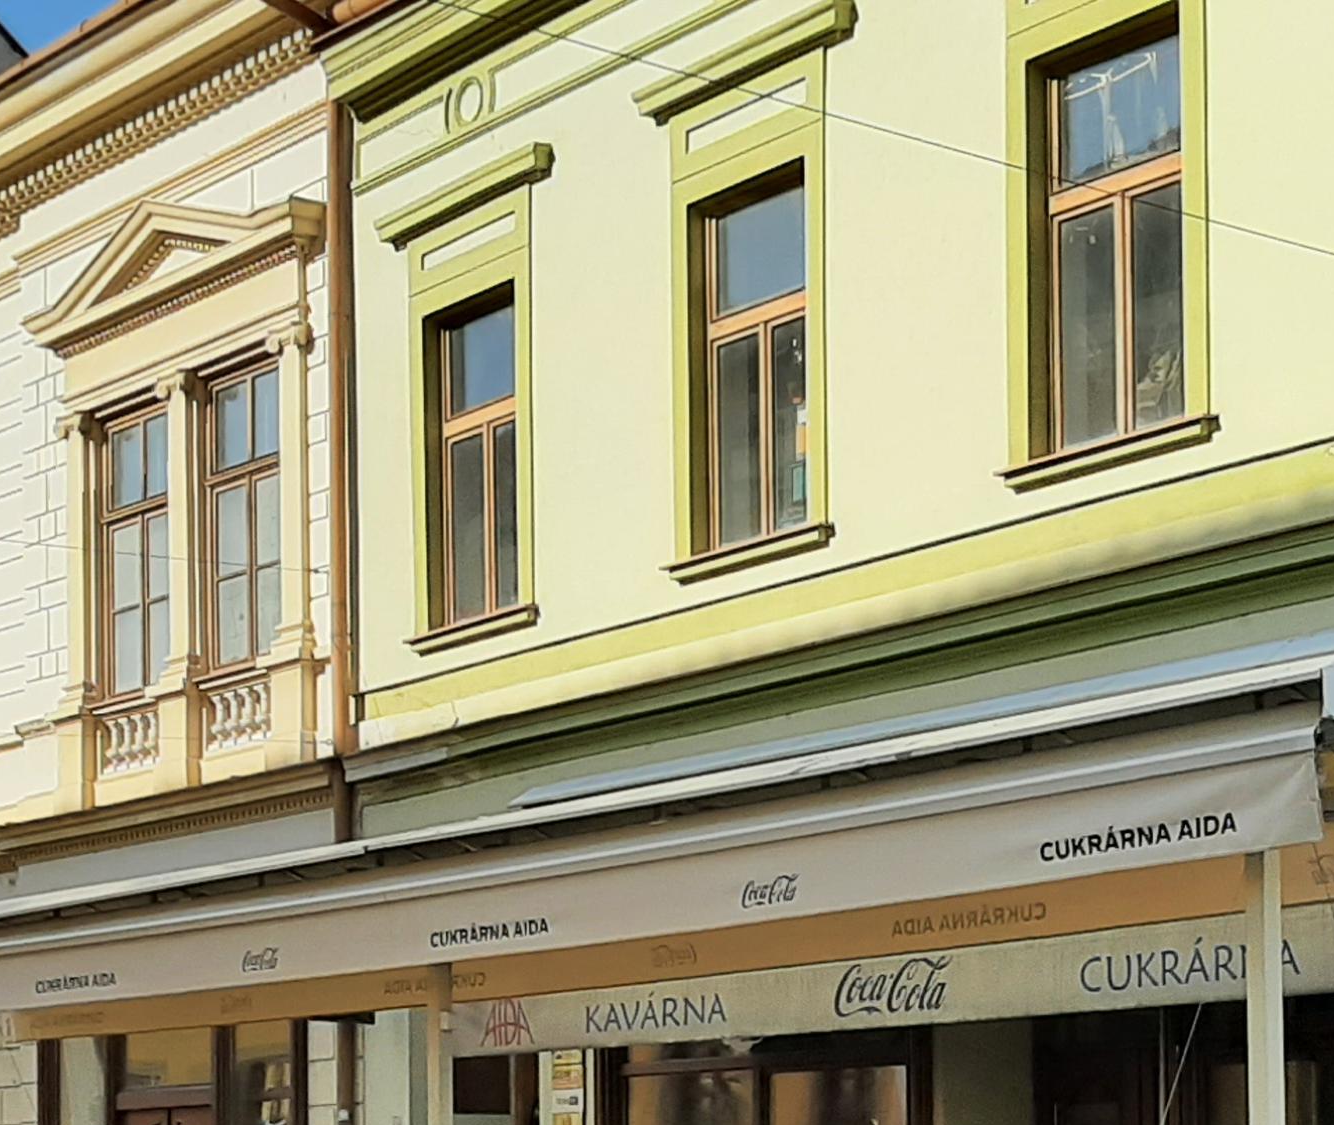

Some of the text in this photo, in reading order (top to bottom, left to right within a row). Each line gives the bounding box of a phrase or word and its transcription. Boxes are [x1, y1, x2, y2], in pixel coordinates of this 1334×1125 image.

[1040, 812, 1237, 861] CUKRÁRNA AIDA
[430, 917, 549, 947] CUKRÁRNA AIDA
[92, 971, 117, 988] AIDA
[833, 955, 953, 1017] Coca-Cola
[1080, 937, 1301, 992] CUKRÁRA
[480, 991, 727, 1047] AIDA KAVÁRNA
